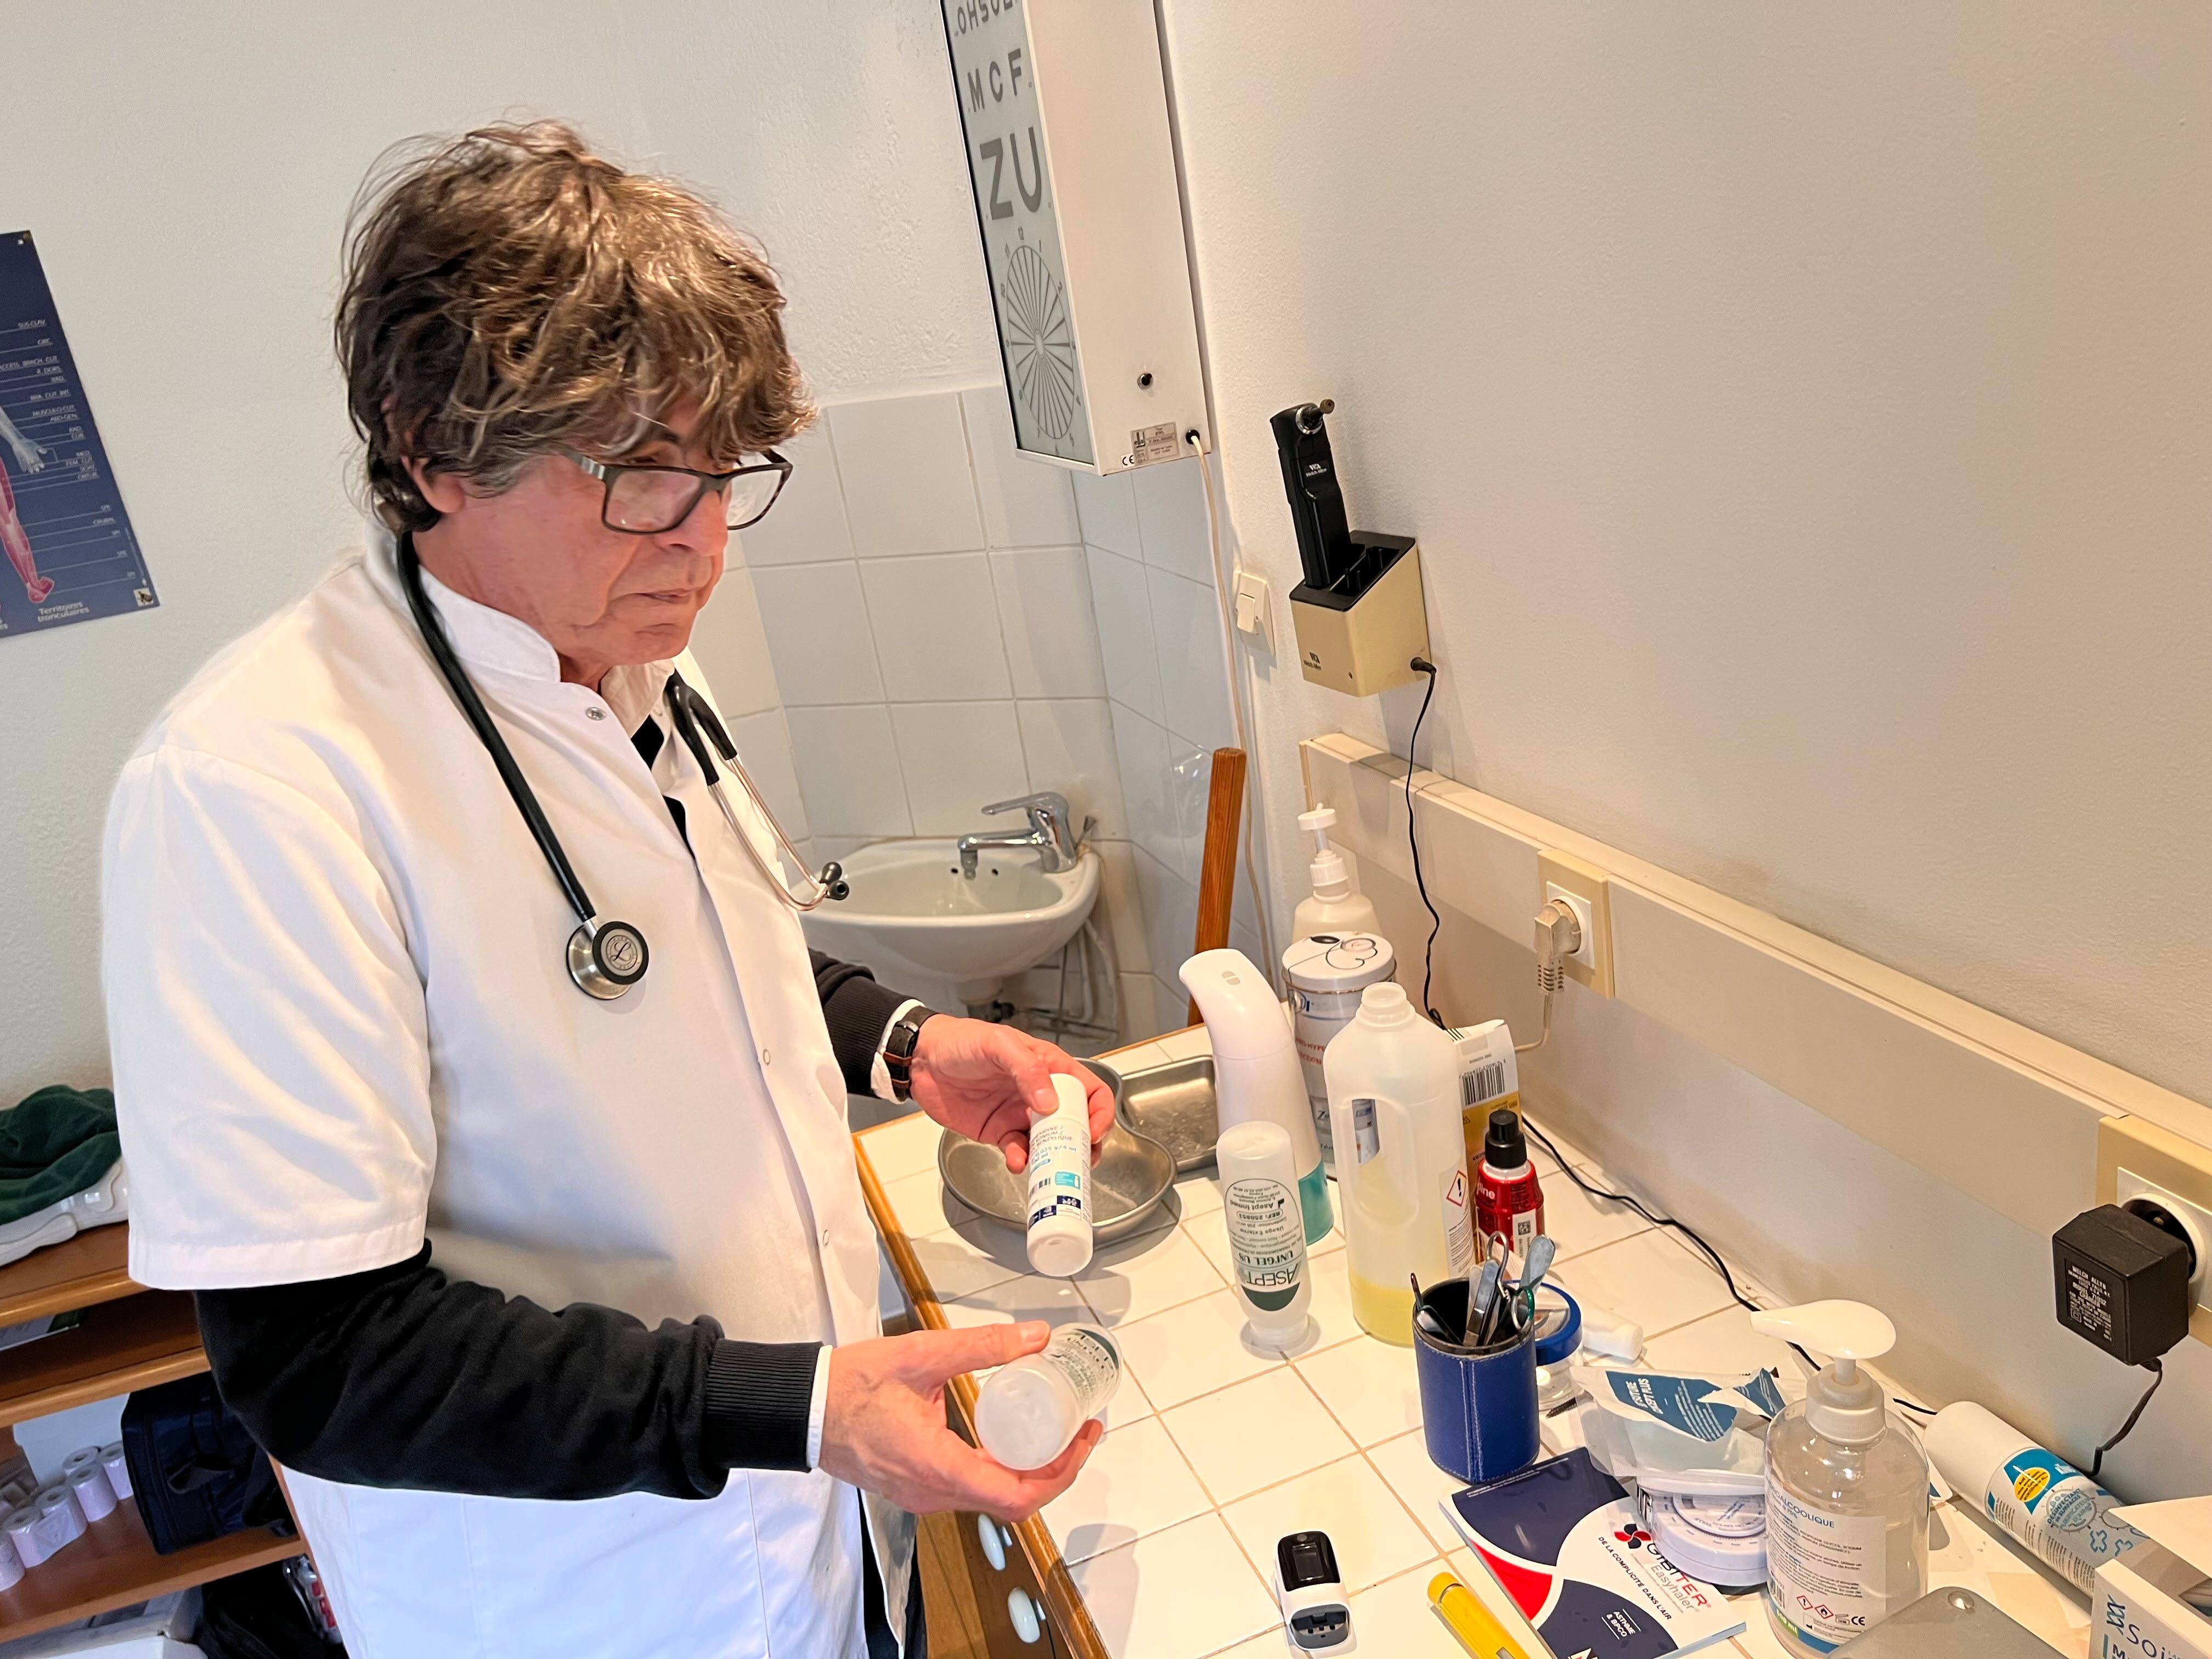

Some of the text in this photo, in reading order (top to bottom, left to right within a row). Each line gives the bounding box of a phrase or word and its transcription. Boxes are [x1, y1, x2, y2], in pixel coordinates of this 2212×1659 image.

[967, 48, 1022, 112] MCF
[979, 127, 1042, 220] ZU
[1238, 1252, 1251, 1264] US
[1246, 1263, 1299, 1286] ASEPT
[1598, 1536, 1672, 1620] DE LA COMPLICITÉ DANS L'AIR
[1651, 1565, 1695, 1612] Easyhaler
[1610, 1619, 1628, 1637] BPCO
[1613, 1611, 1636, 1635] ASTHME
[1851, 1616, 1865, 1626] CE
